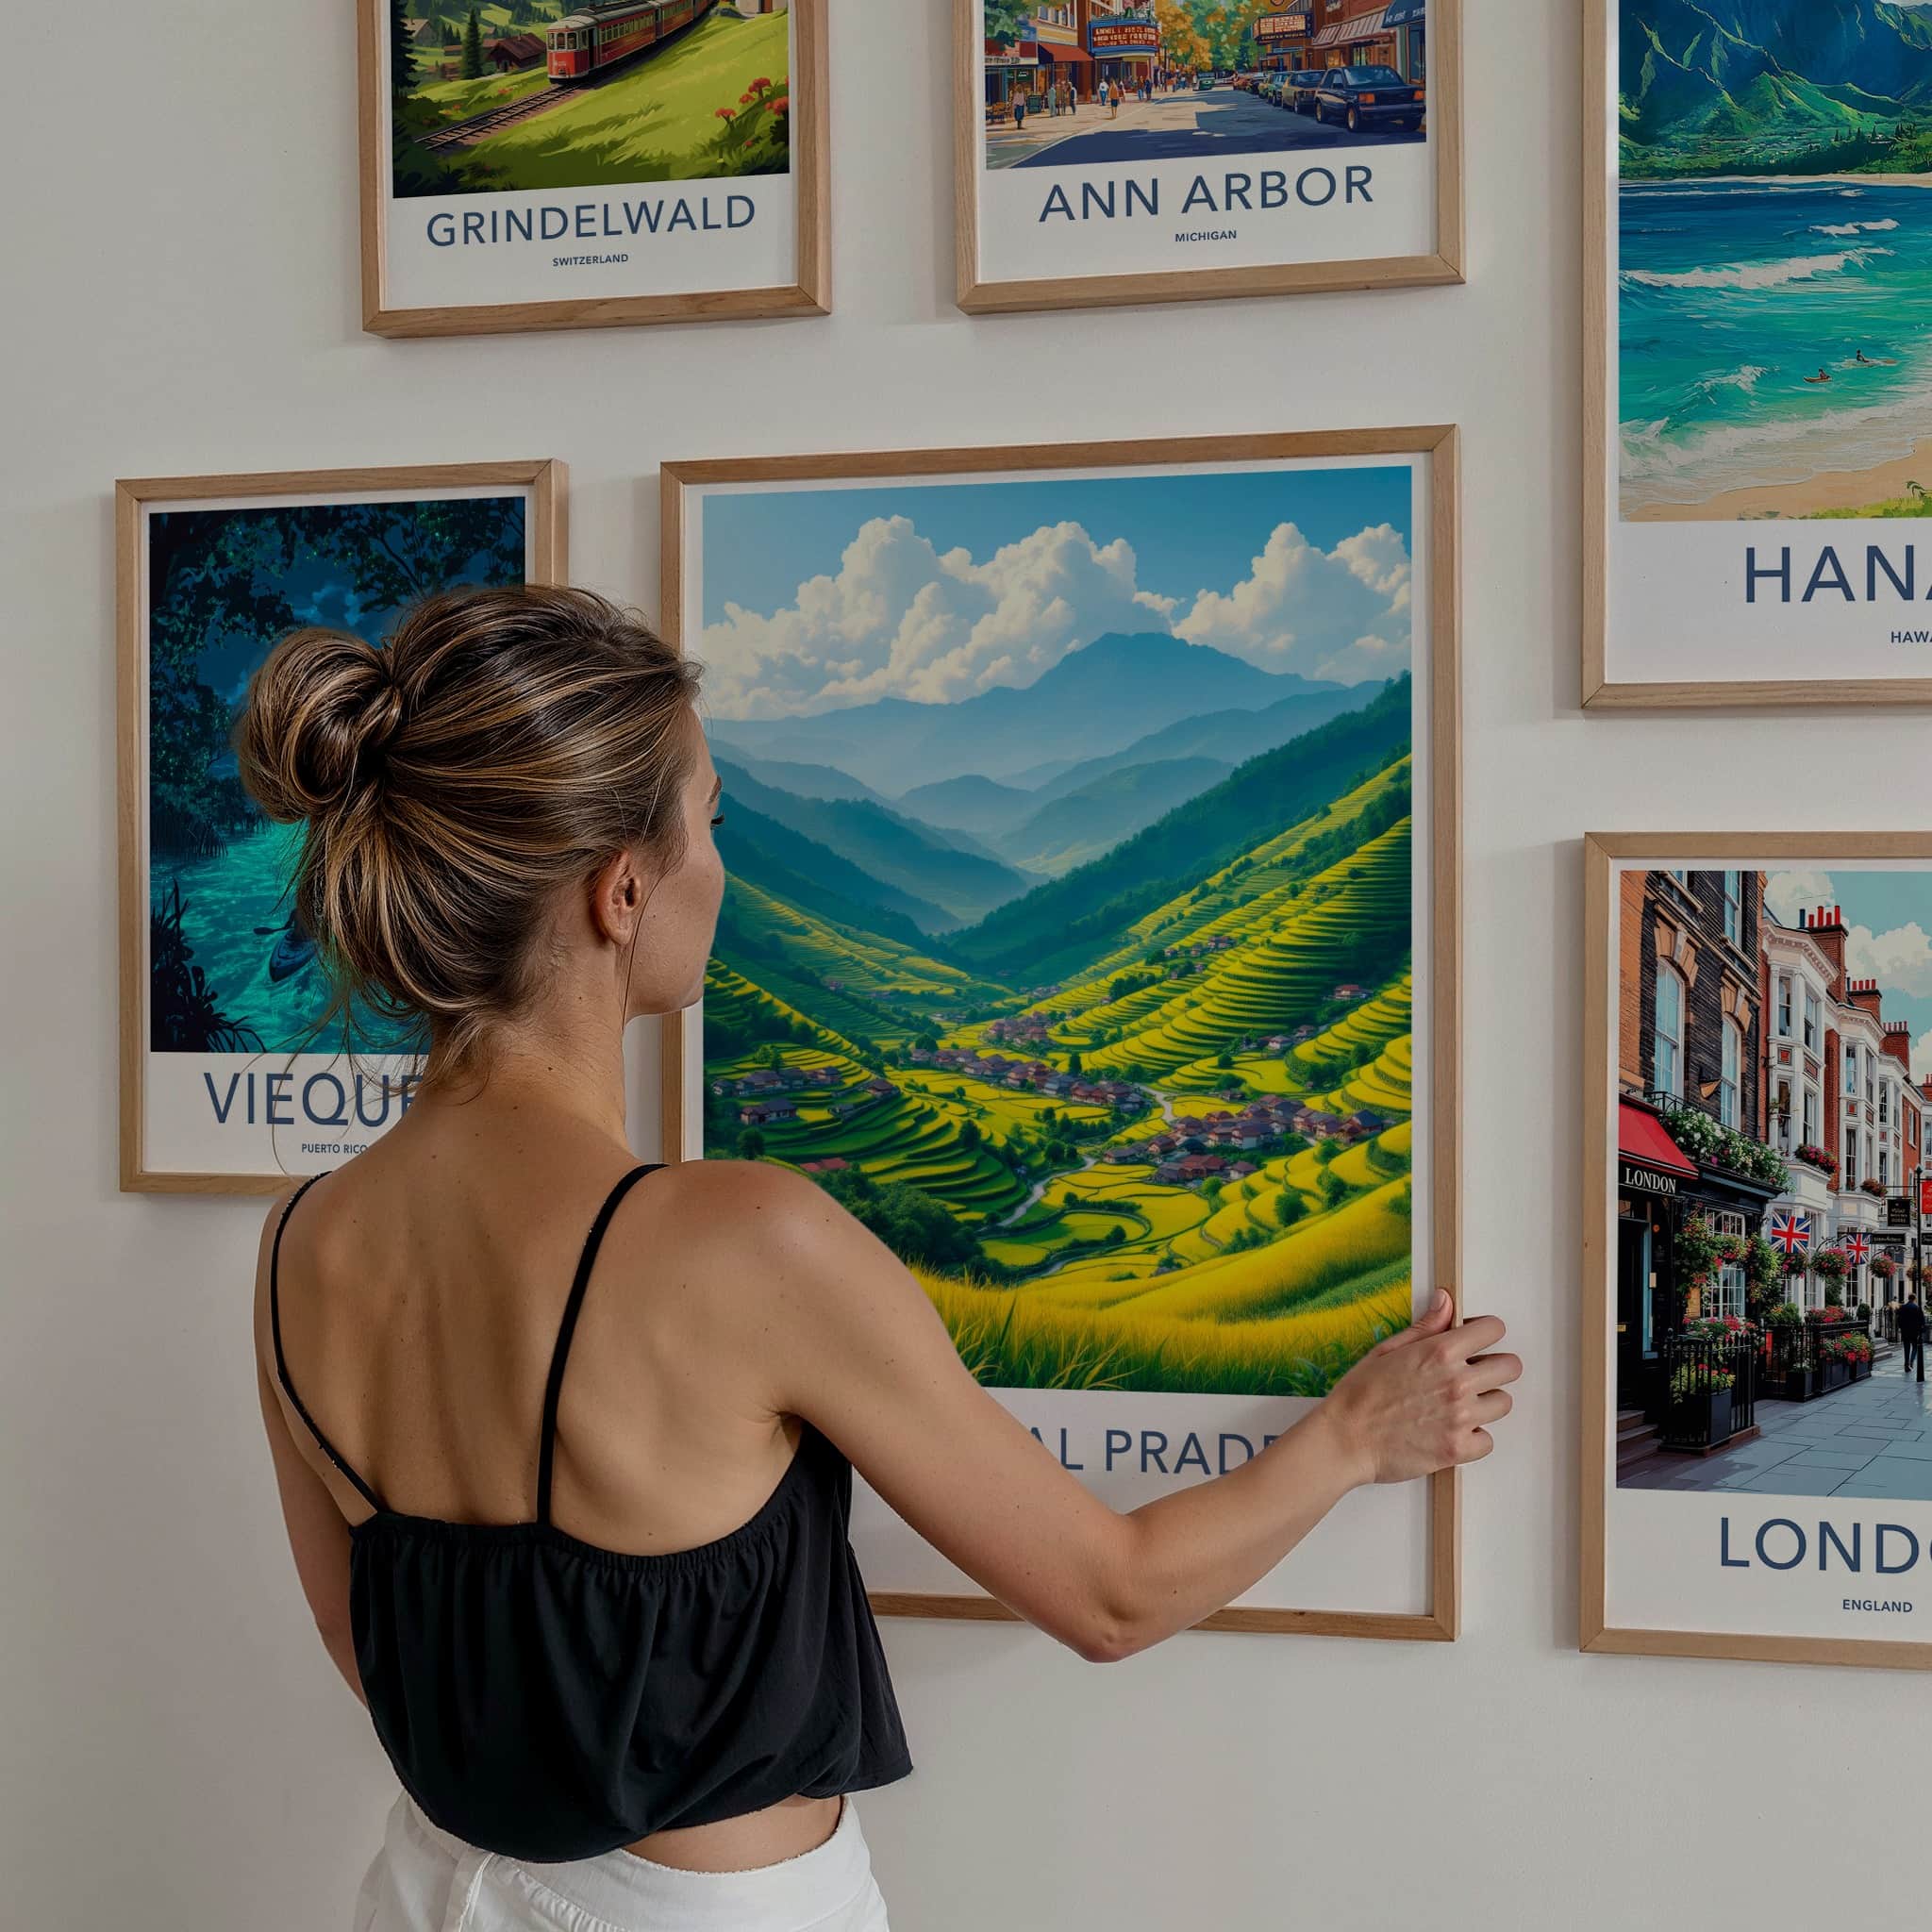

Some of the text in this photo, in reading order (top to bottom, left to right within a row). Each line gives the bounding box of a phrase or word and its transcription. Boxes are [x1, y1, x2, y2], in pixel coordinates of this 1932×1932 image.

[1039, 165, 1374, 223] ANN ARBOR
[426, 194, 756, 247] GRINDELWALD
[1174, 229, 1238, 242] MICHIGAN
[552, 254, 629, 267] SWITZERLAND
[1745, 544, 1932, 603] HAN
[1890, 630, 1932, 643] HAW
[301, 1143, 369, 1154] PUERTO RICO
[1624, 1167, 1676, 1193] LONDON
[1721, 1517, 1932, 1574] LOND
[1842, 1599, 1913, 1613] ENGLAND
